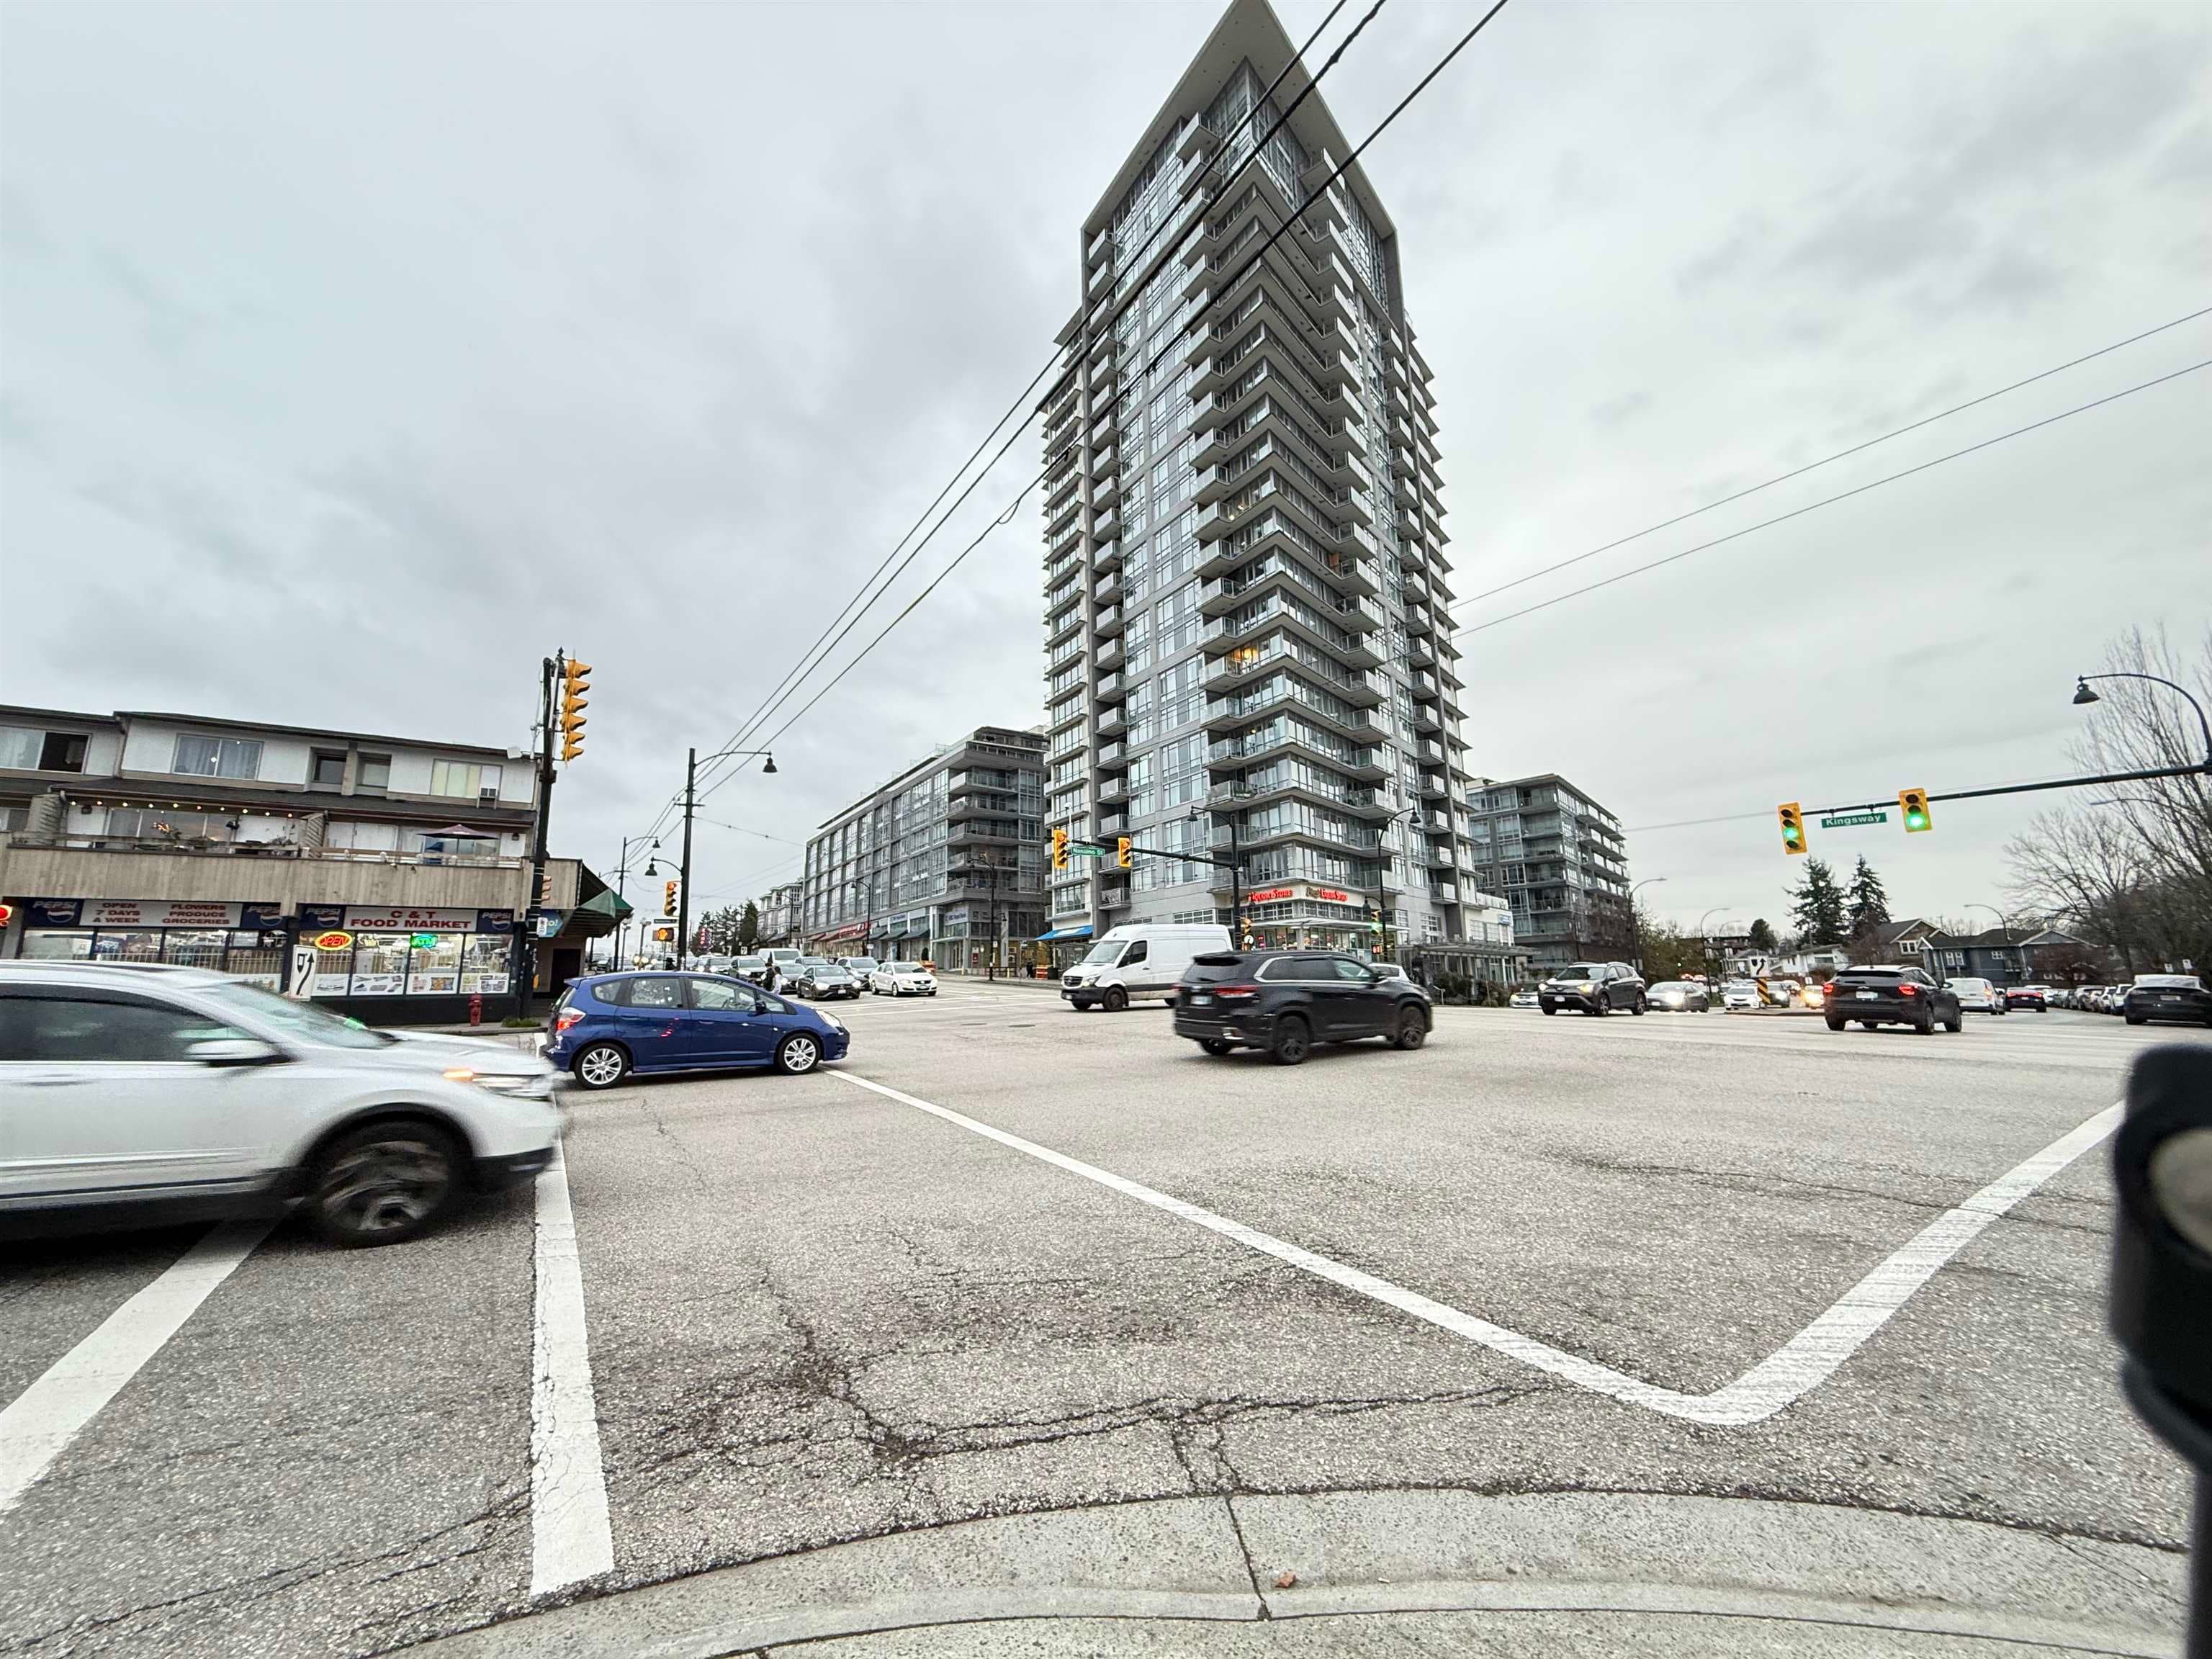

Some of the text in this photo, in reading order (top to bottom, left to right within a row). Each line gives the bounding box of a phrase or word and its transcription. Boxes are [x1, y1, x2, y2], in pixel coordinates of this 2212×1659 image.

[1826, 814, 1881, 826] Kingsway
[351, 919, 471, 929] FOOD MARKET
[320, 936, 349, 945] OPEN
